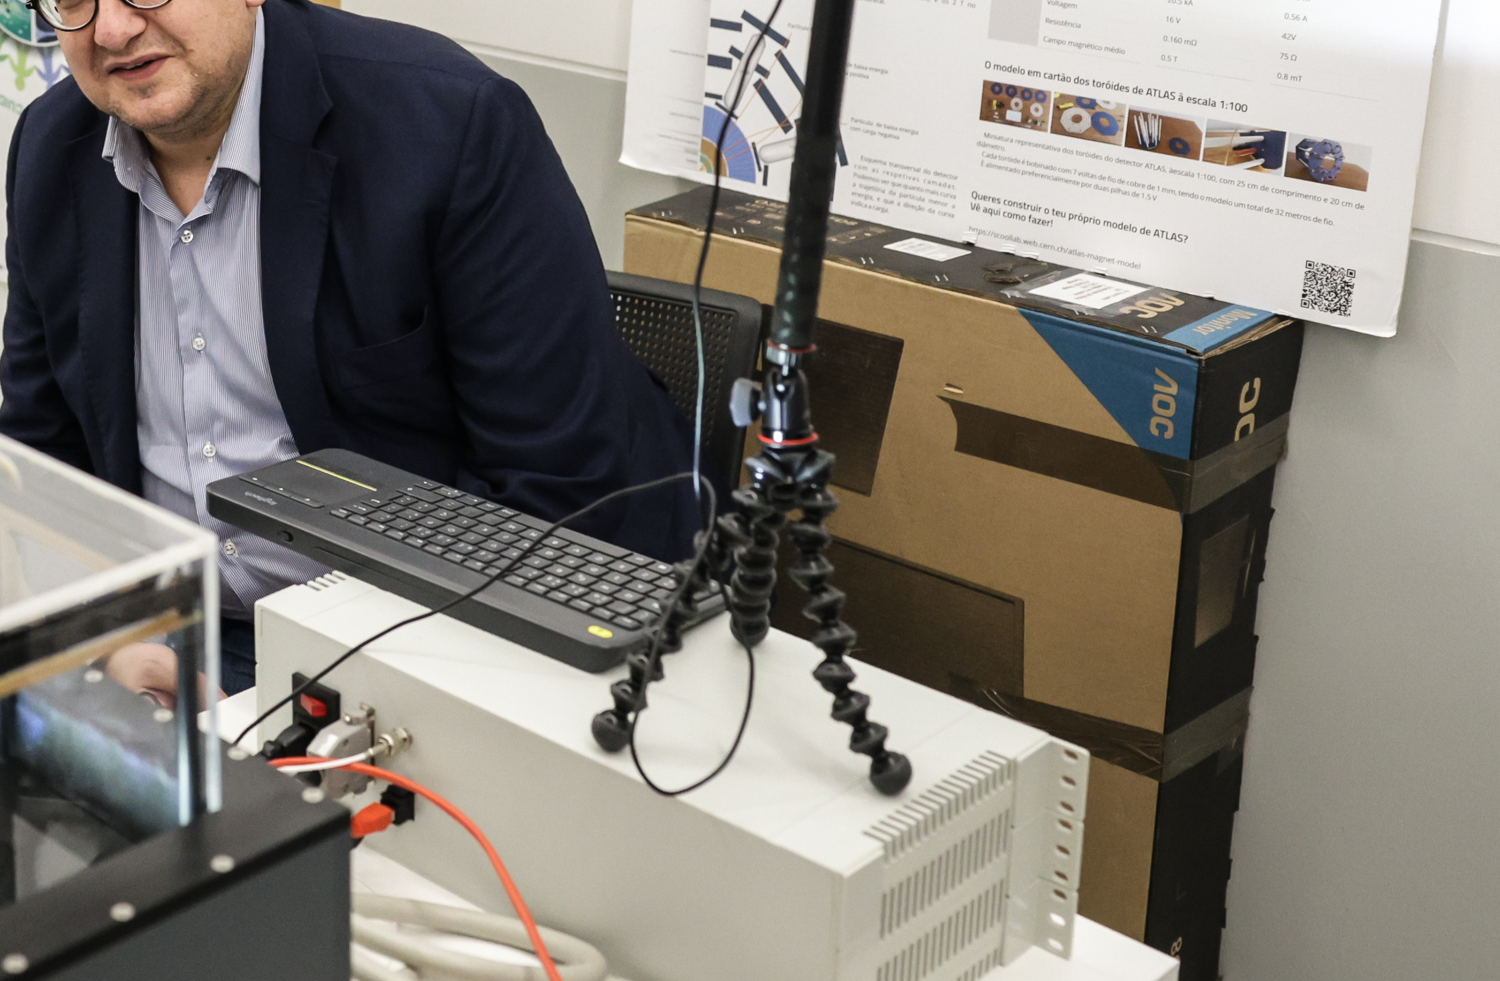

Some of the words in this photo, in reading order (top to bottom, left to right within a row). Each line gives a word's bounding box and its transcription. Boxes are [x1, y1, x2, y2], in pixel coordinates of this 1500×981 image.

[1043, 36, 1066, 45] Campo
[1067, 41, 1103, 51] magnético
[1103, 46, 1125, 55] médio
[993, 64, 1025, 75] modelo
[1027, 69, 1041, 78] em
[1043, 72, 1071, 83] cartão
[1073, 76, 1090, 86] dos
[1092, 79, 1130, 92] toróides
[1131, 85, 1144, 95] de
[1145, 88, 1176, 100] ATLAS
[1186, 96, 1216, 107] escala
[1220, 100, 1248, 112] 1:100
[970, 202, 981, 212] Vê
[982, 206, 1001, 216] aqui
[1002, 211, 1026, 221] como
[1028, 214, 1053, 227] fazer!
[971, 190, 1001, 206] Queres
[1003, 199, 1042, 216] construir
[1052, 208, 1066, 218] teu
[1068, 212, 1101, 225] próprio
[1103, 220, 1137, 233] modelo
[1139, 226, 1151, 236] de
[1153, 229, 1188, 243] ATLAS?
[1192, 308, 1258, 336] Monitor
